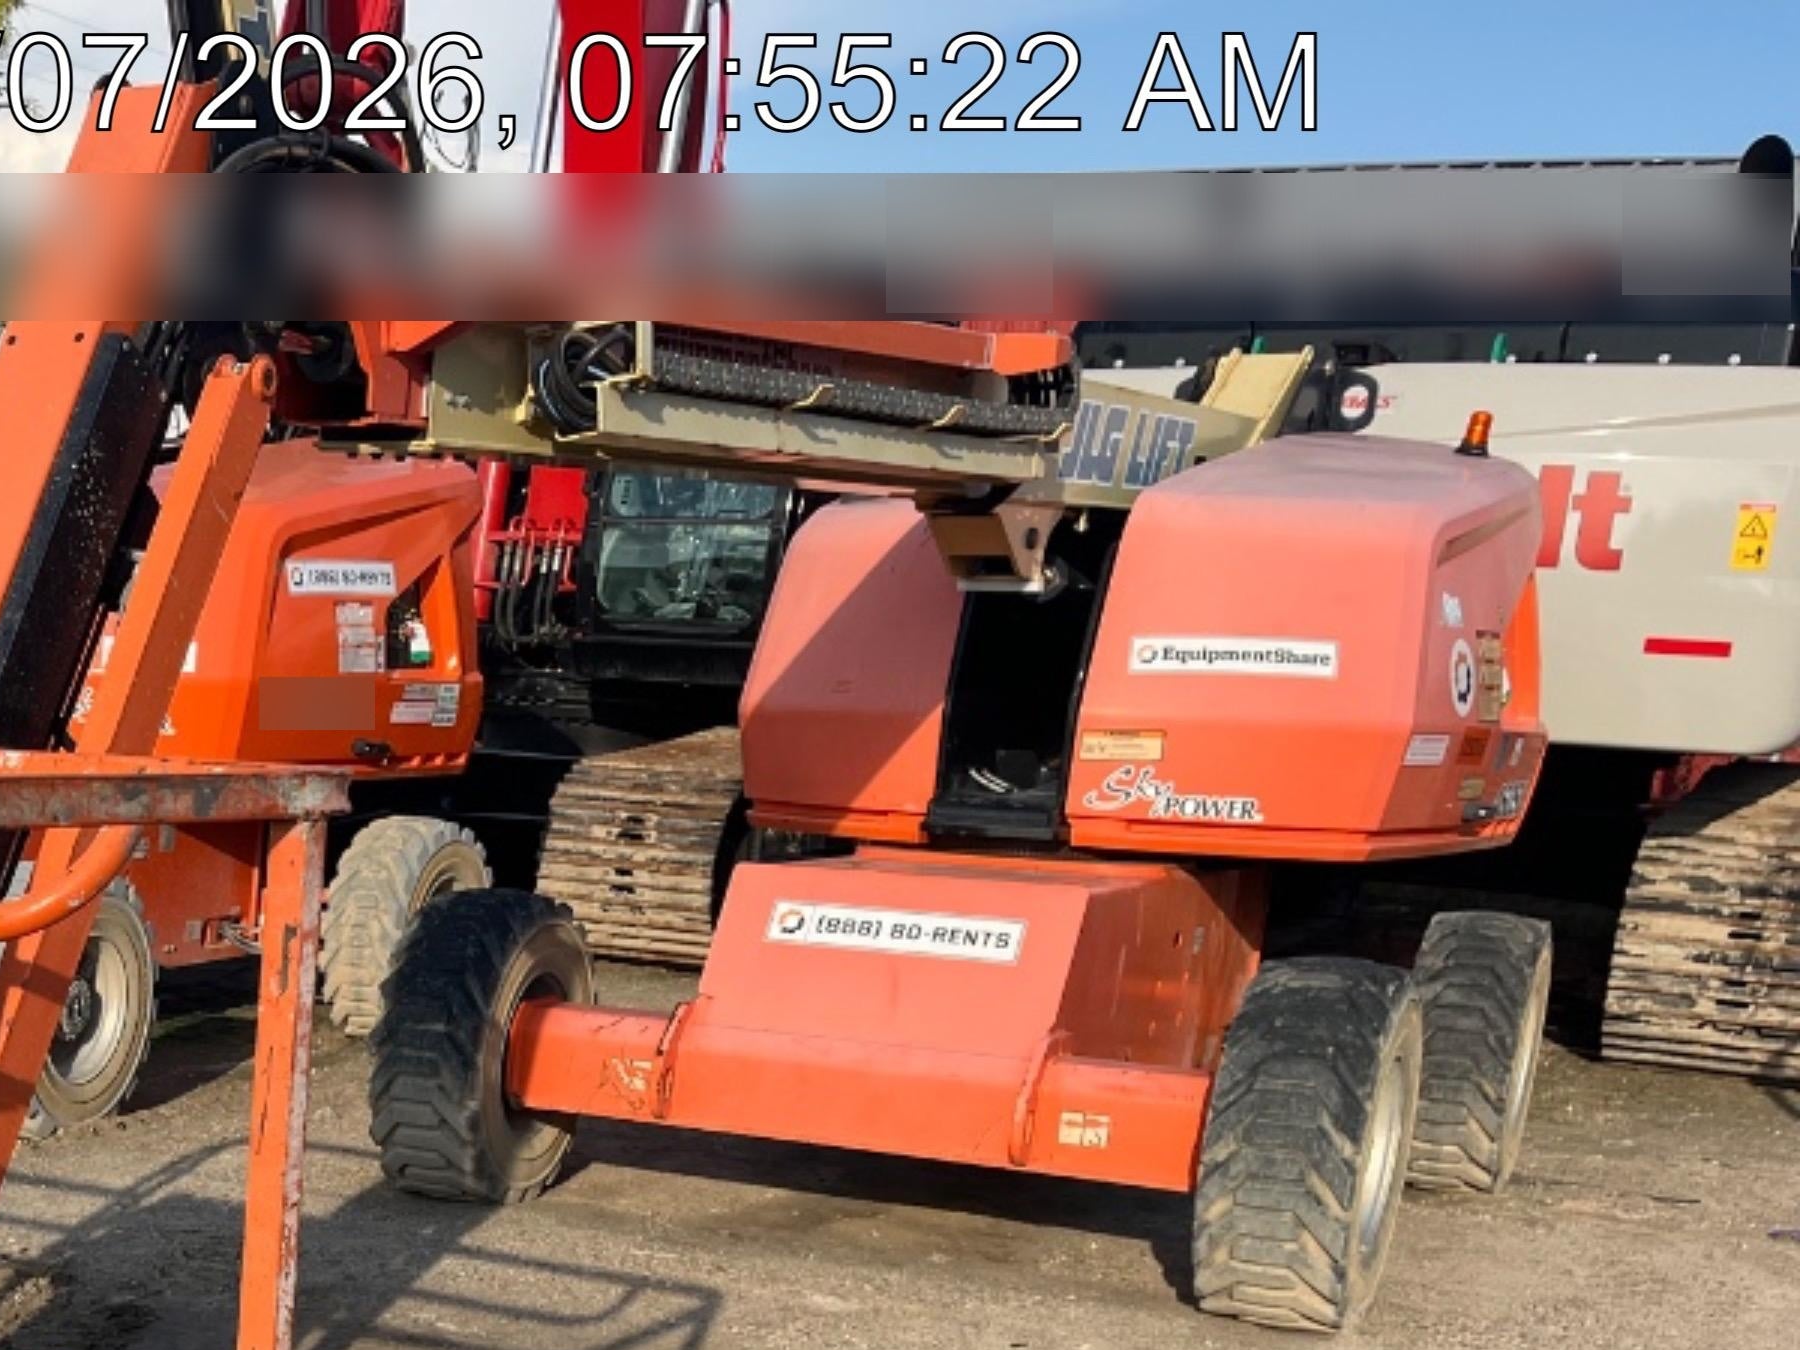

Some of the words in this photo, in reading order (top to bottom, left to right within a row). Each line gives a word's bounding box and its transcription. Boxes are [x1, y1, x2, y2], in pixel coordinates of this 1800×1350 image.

[1056, 399, 1131, 487] JLG
[1122, 409, 1196, 489] LIFT
[1161, 645, 1332, 667] EquipmentShare
[815, 914, 883, 940] (888)
[890, 922, 1011, 951] 80-RENTS
